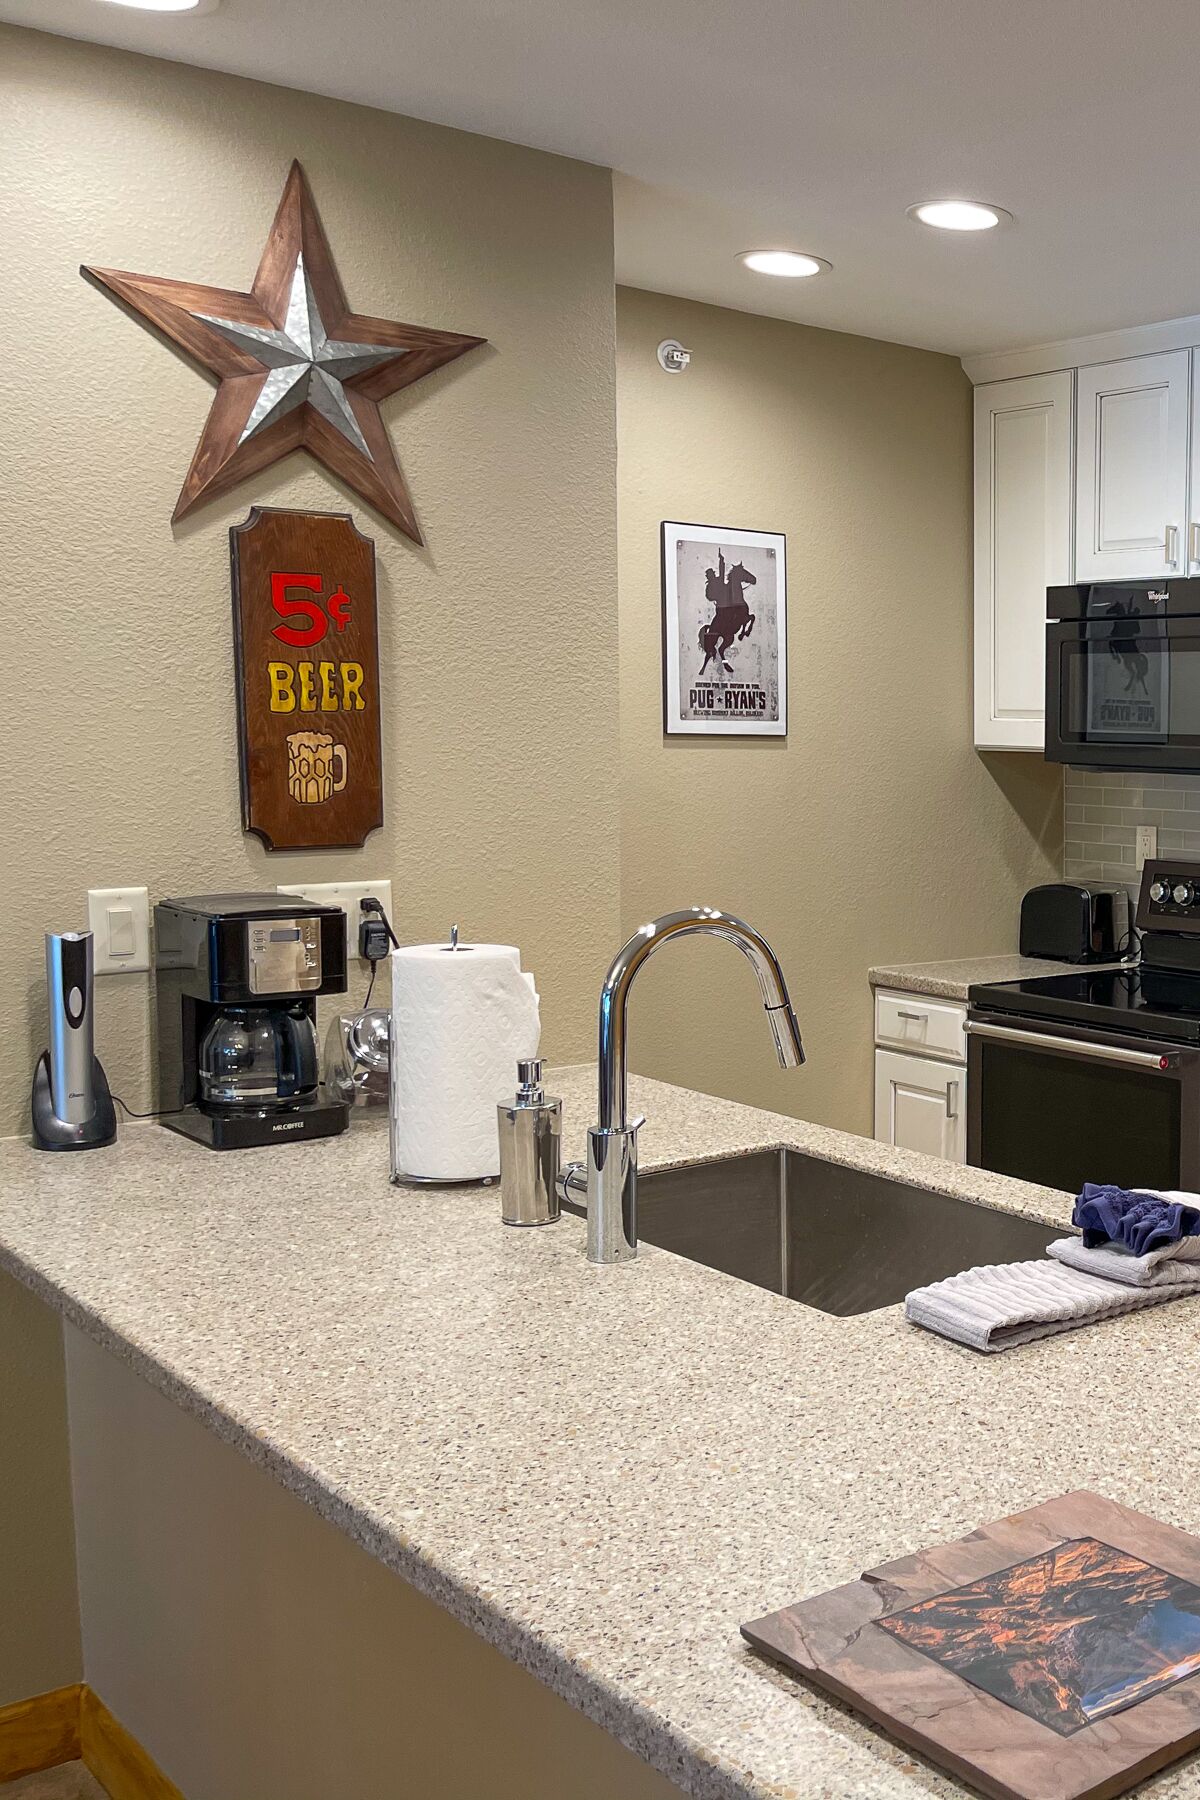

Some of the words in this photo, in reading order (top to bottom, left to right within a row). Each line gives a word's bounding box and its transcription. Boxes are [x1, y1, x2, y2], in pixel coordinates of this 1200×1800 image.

[267, 661, 366, 713] BEER
[690, 689, 714, 708] PUG
[725, 691, 766, 709] RYAN'S
